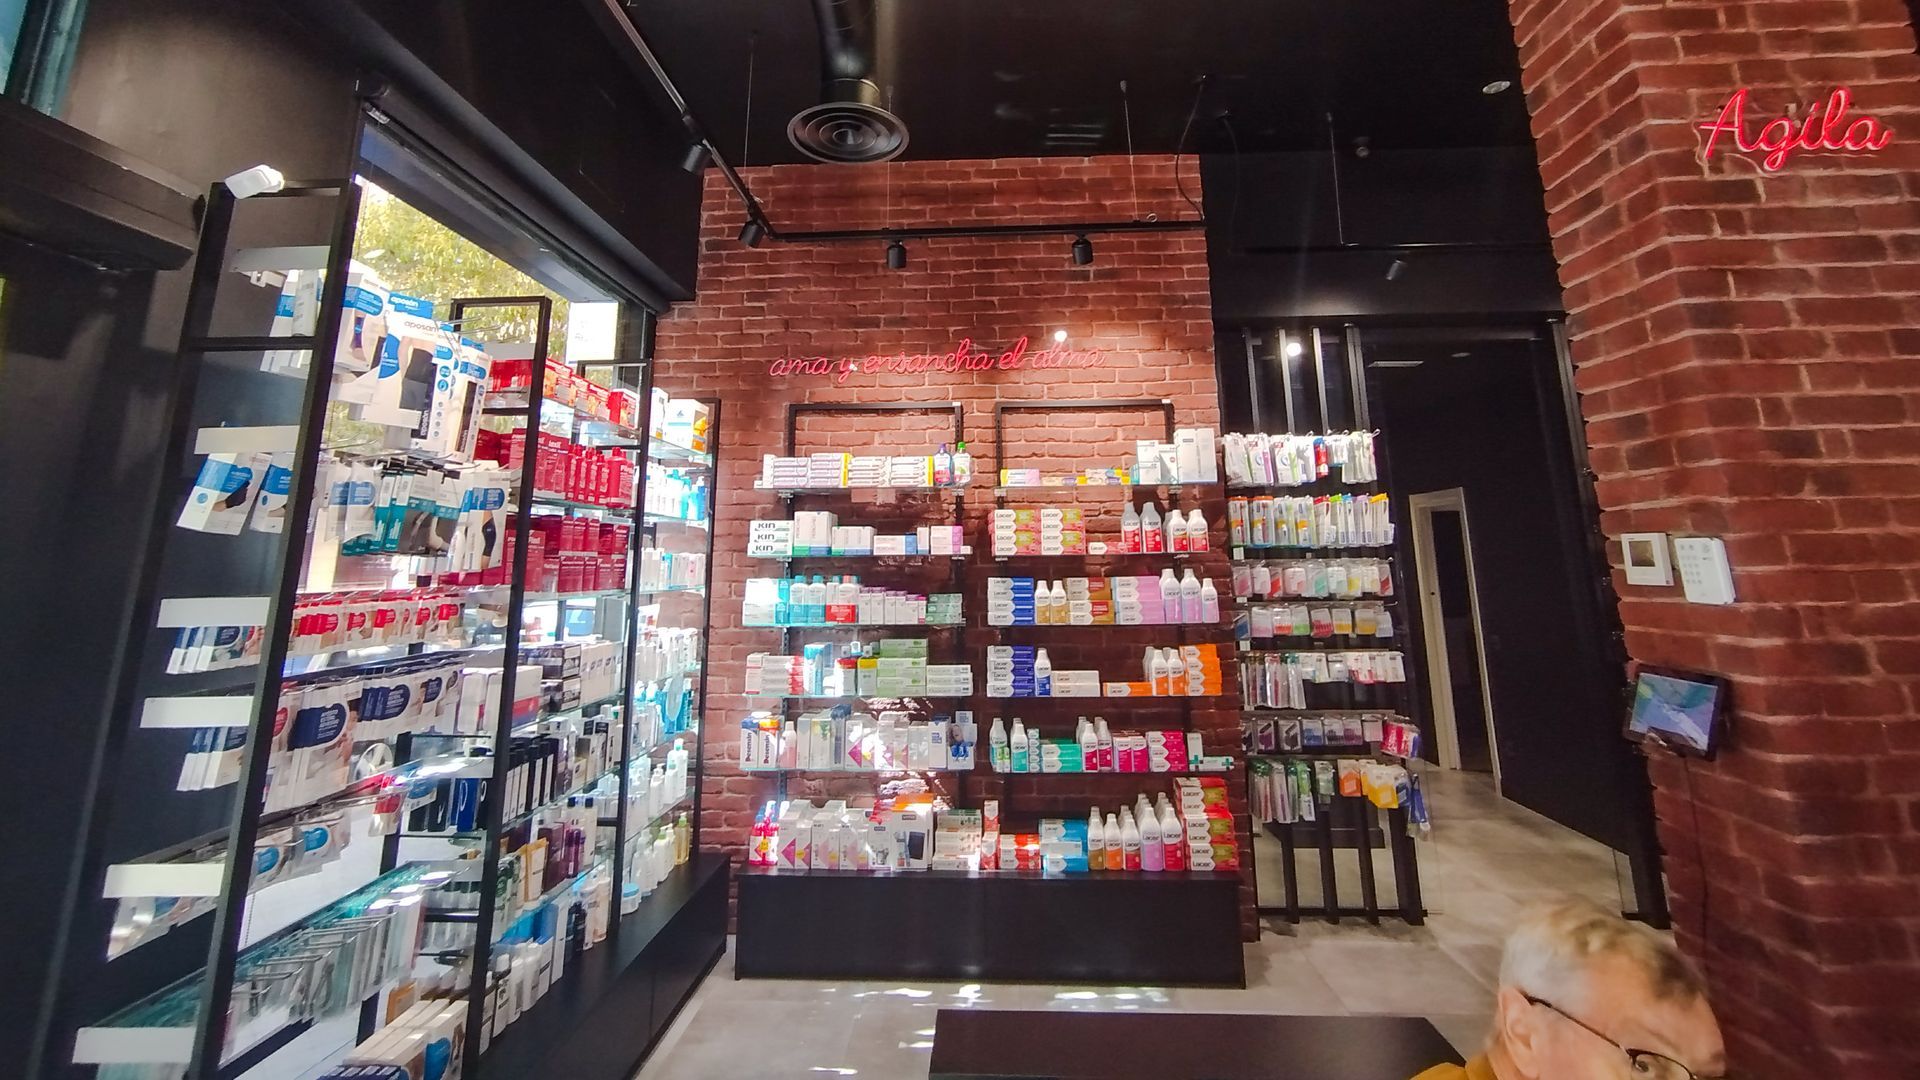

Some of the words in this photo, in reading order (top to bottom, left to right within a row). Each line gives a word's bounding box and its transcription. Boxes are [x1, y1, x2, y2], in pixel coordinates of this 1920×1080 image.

[769, 356, 833, 377] ama
[838, 356, 856, 383] y
[863, 337, 994, 374] ensancha
[999, 336, 1029, 370] el
[1032, 341, 1105, 369] alma
